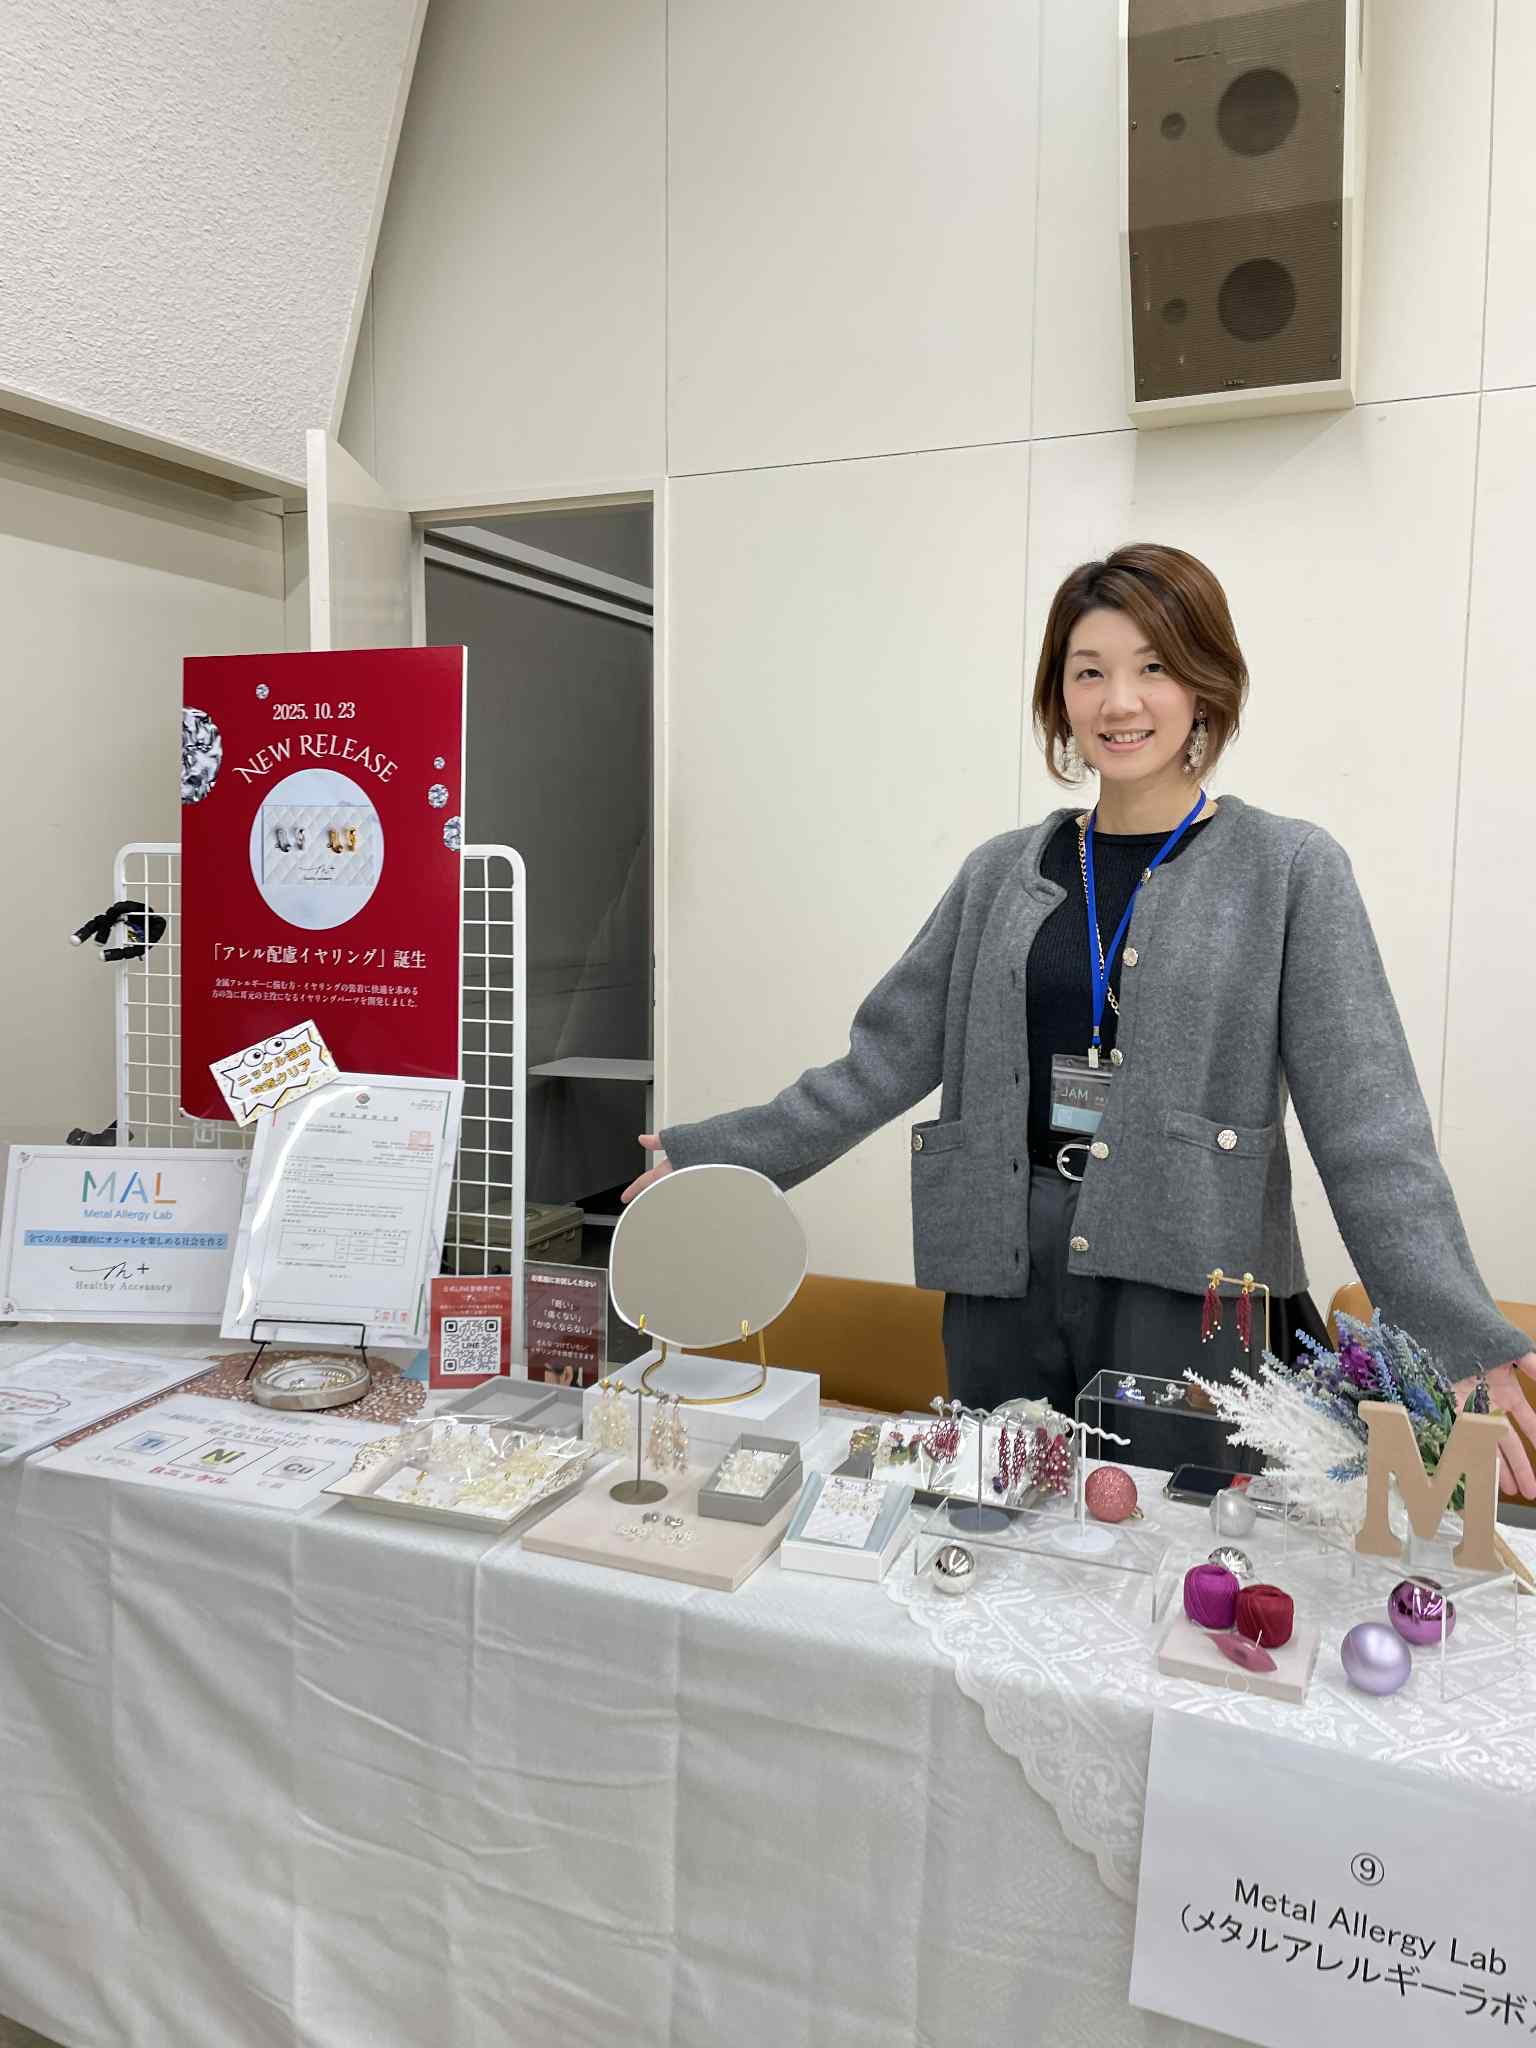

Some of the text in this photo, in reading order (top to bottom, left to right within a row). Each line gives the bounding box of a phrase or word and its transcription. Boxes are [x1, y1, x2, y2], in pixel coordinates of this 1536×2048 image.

[272, 702, 356, 721] 2025. 10. 23
[232, 733, 399, 784] NEW RELEASE
[82, 1170, 176, 1203] MAL
[84, 1208, 112, 1219] Metal
[153, 1210, 173, 1220] Lab
[282, 1463, 312, 1475] Cu
[1355, 1402, 1510, 1570] M
[1234, 1878, 1508, 1976] Metal Allergy Lab
